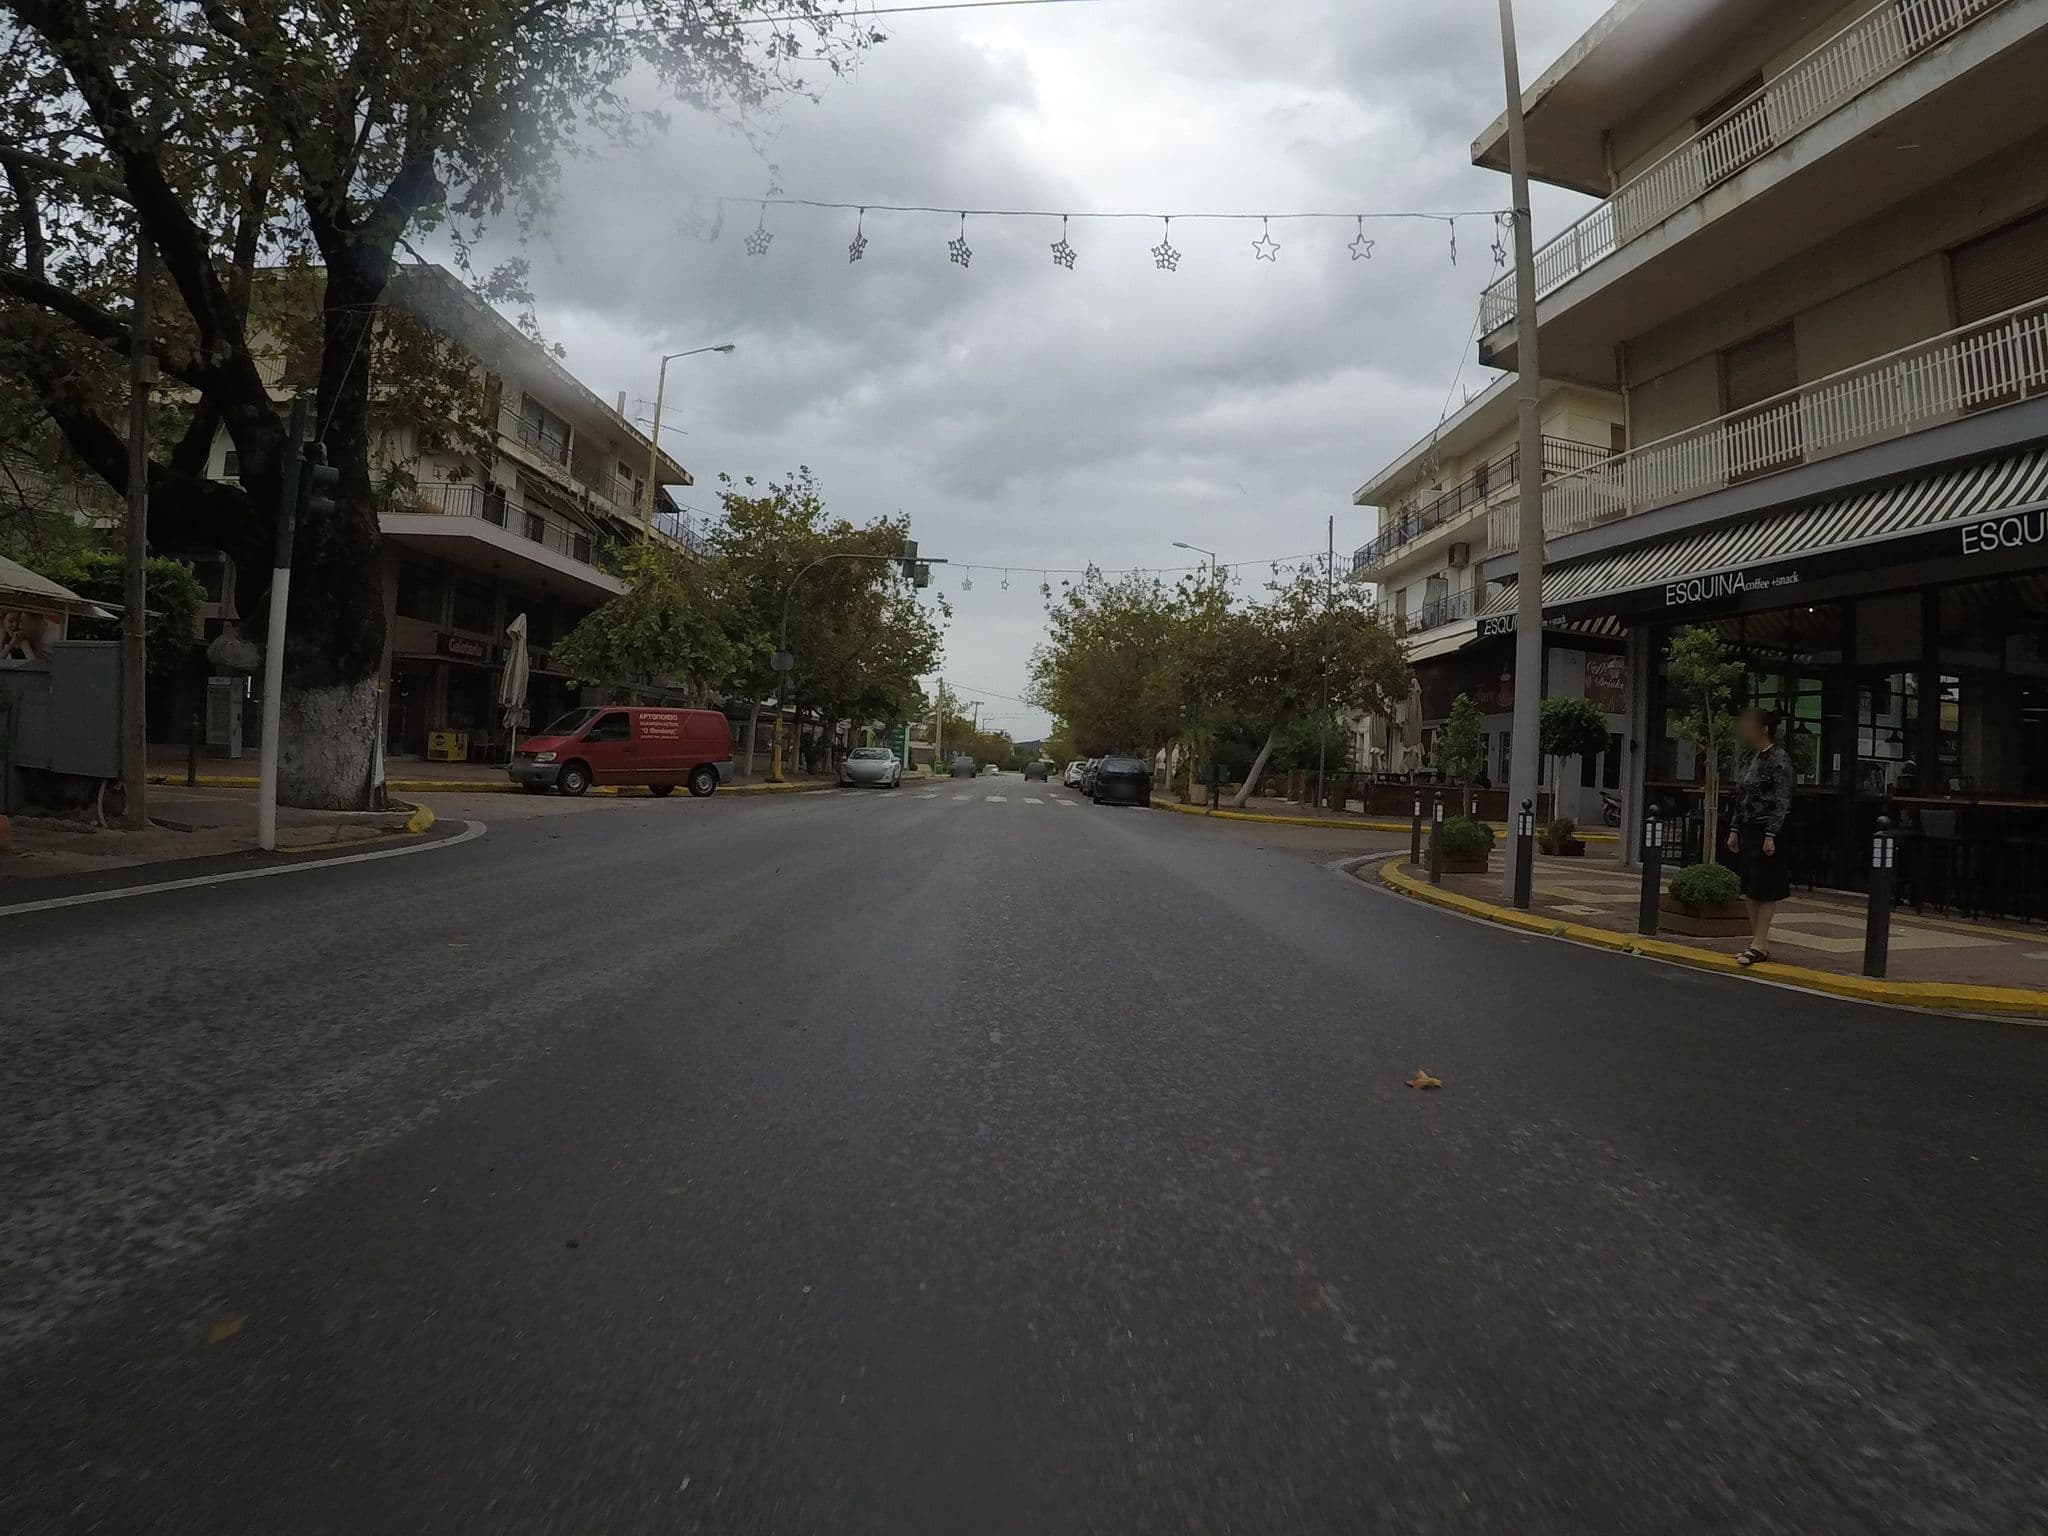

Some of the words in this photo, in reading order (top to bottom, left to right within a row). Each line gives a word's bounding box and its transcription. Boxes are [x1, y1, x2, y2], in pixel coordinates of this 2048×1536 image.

[1961, 512, 2048, 555] ESQU
[1665, 571, 1746, 606] ESQUINA
[1745, 578, 1770, 591] coffee
[1483, 614, 1518, 636] ESQUI
